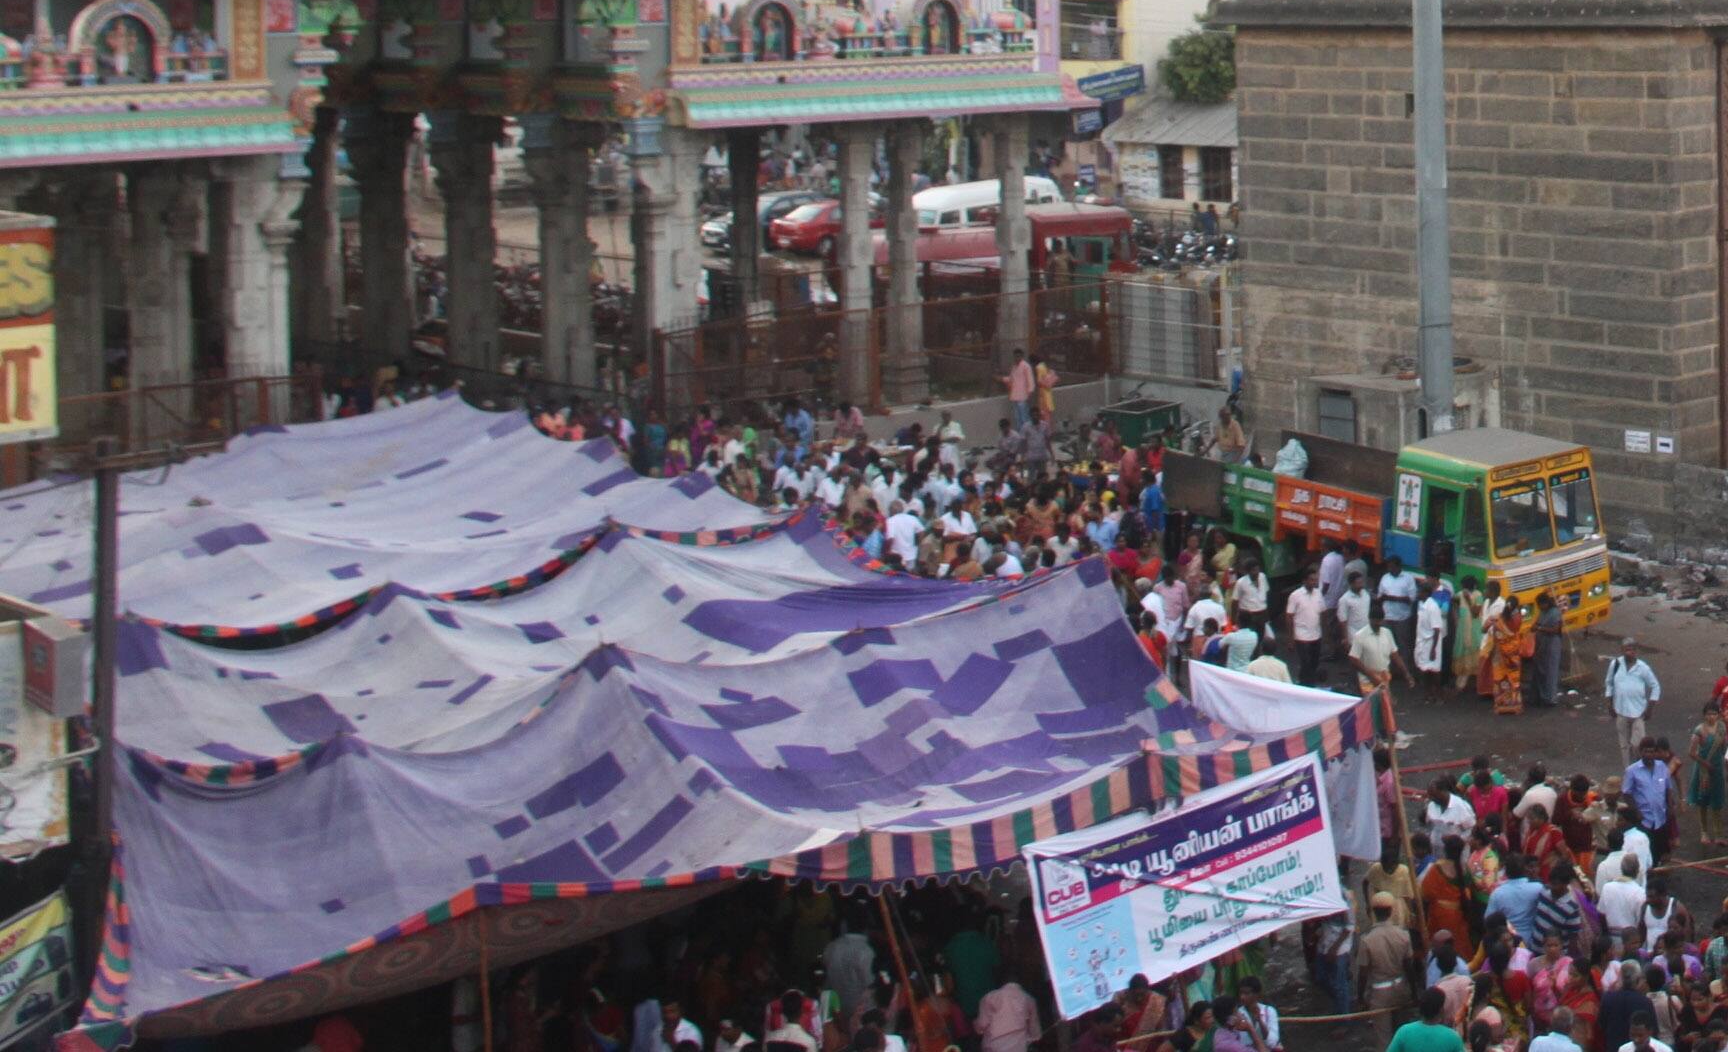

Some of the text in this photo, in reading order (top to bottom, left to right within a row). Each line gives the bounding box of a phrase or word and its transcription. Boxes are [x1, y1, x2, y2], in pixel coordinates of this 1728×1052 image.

[1146, 814, 1243, 875] யூனியன்
[1246, 784, 1315, 834] பாங்க்
[1048, 881, 1086, 906] CUB
